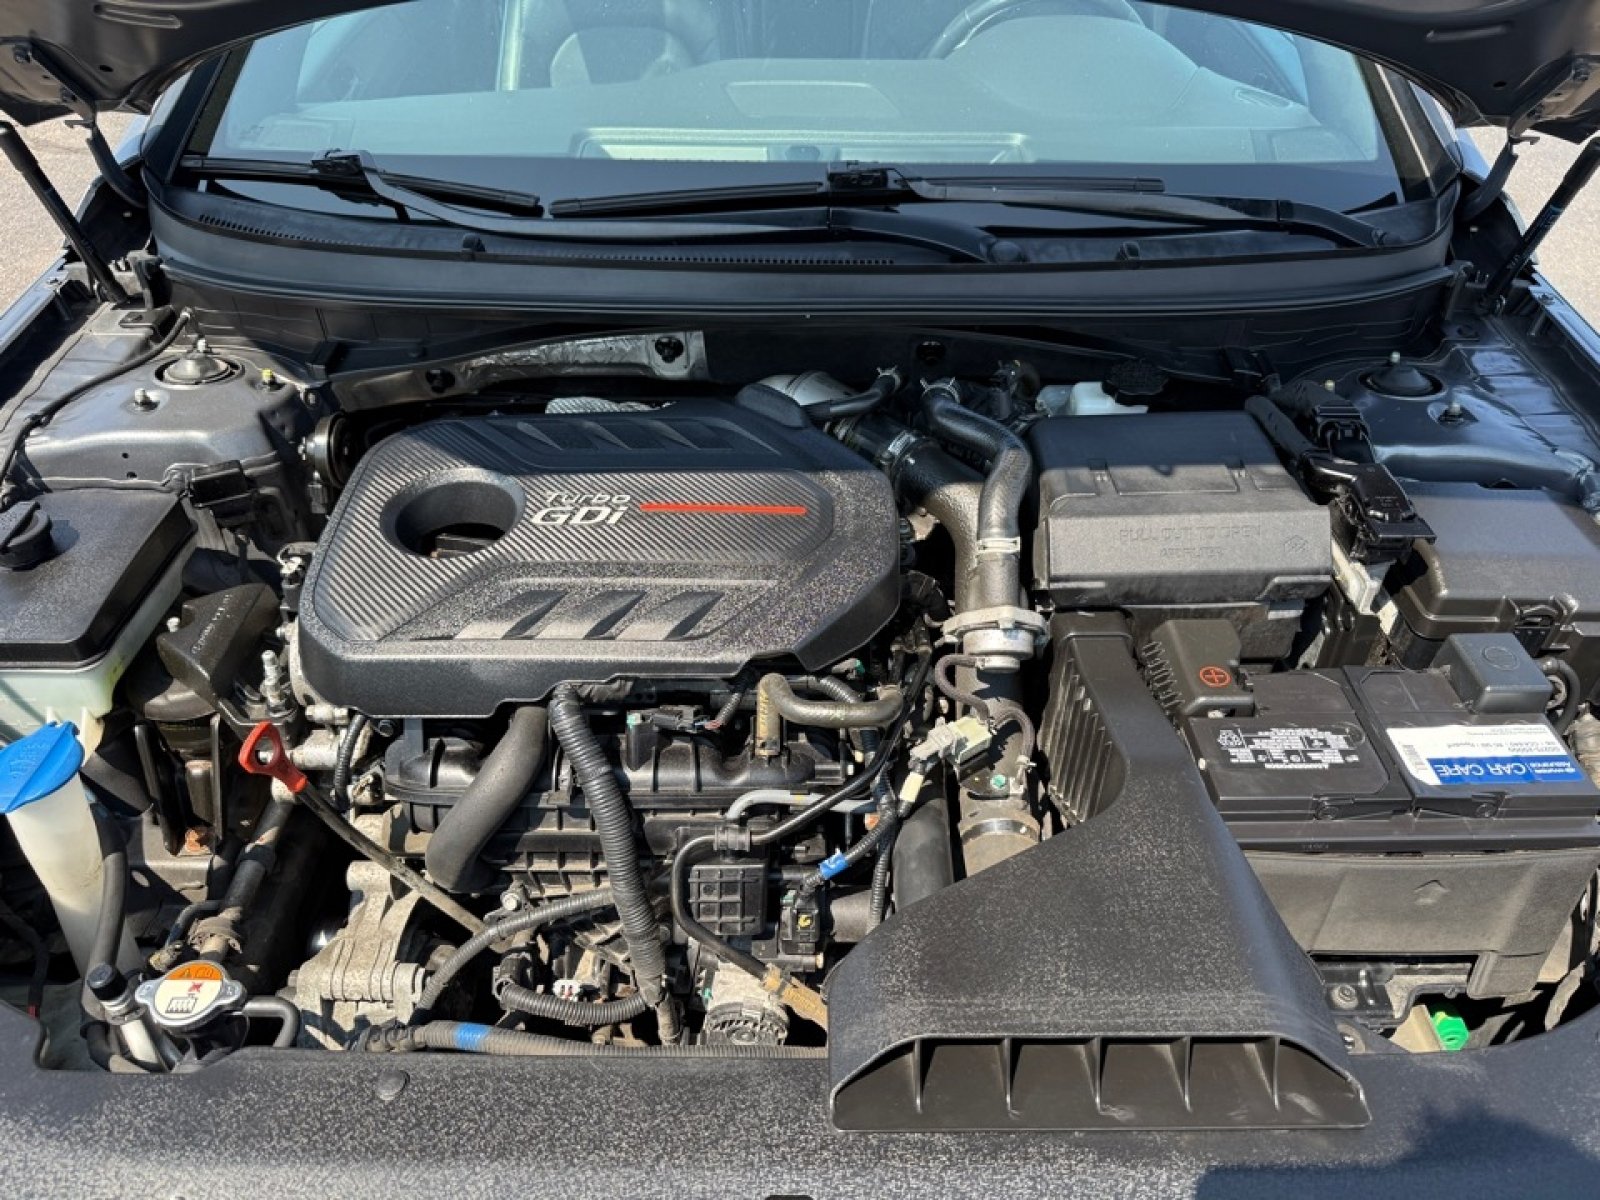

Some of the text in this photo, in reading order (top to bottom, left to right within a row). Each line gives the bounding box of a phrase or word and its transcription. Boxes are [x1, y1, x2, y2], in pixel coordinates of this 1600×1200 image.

[545, 491, 631, 503] Turbo
[531, 506, 629, 525] GDi
[1119, 525, 1261, 543] PULL OUT TO OPEN
[1434, 763, 1485, 776] CARE
[1486, 762, 1527, 775] CAR
